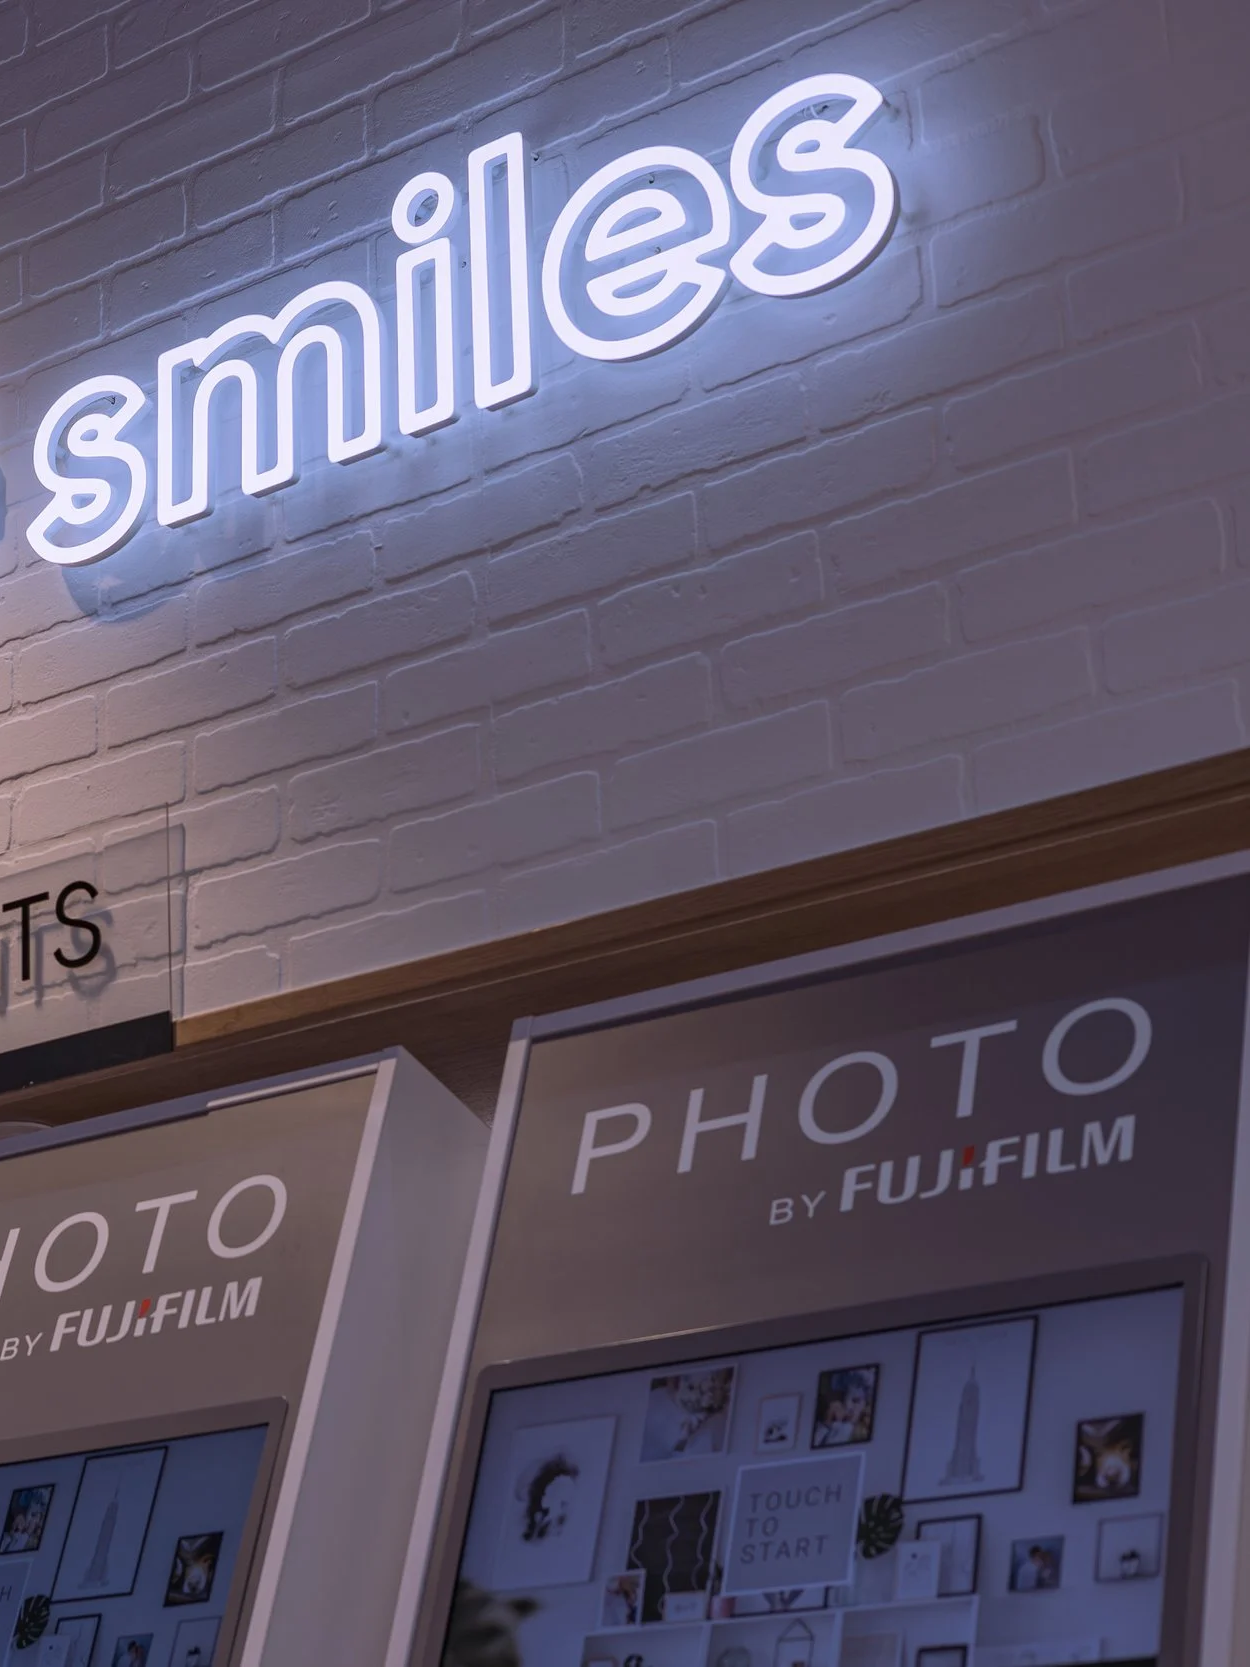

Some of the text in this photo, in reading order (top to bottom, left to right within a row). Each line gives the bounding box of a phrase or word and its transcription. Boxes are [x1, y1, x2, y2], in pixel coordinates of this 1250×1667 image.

[26, 72, 898, 565] smiles
[570, 997, 1152, 1196] PHOTO
[769, 1115, 1136, 1225] BY FUJIFILM
[0, 1277, 263, 1361] BY FUJIFILM
[747, 1516, 779, 1538] TO
[751, 1484, 843, 1513] TOUCH
[740, 1535, 828, 1564] START
